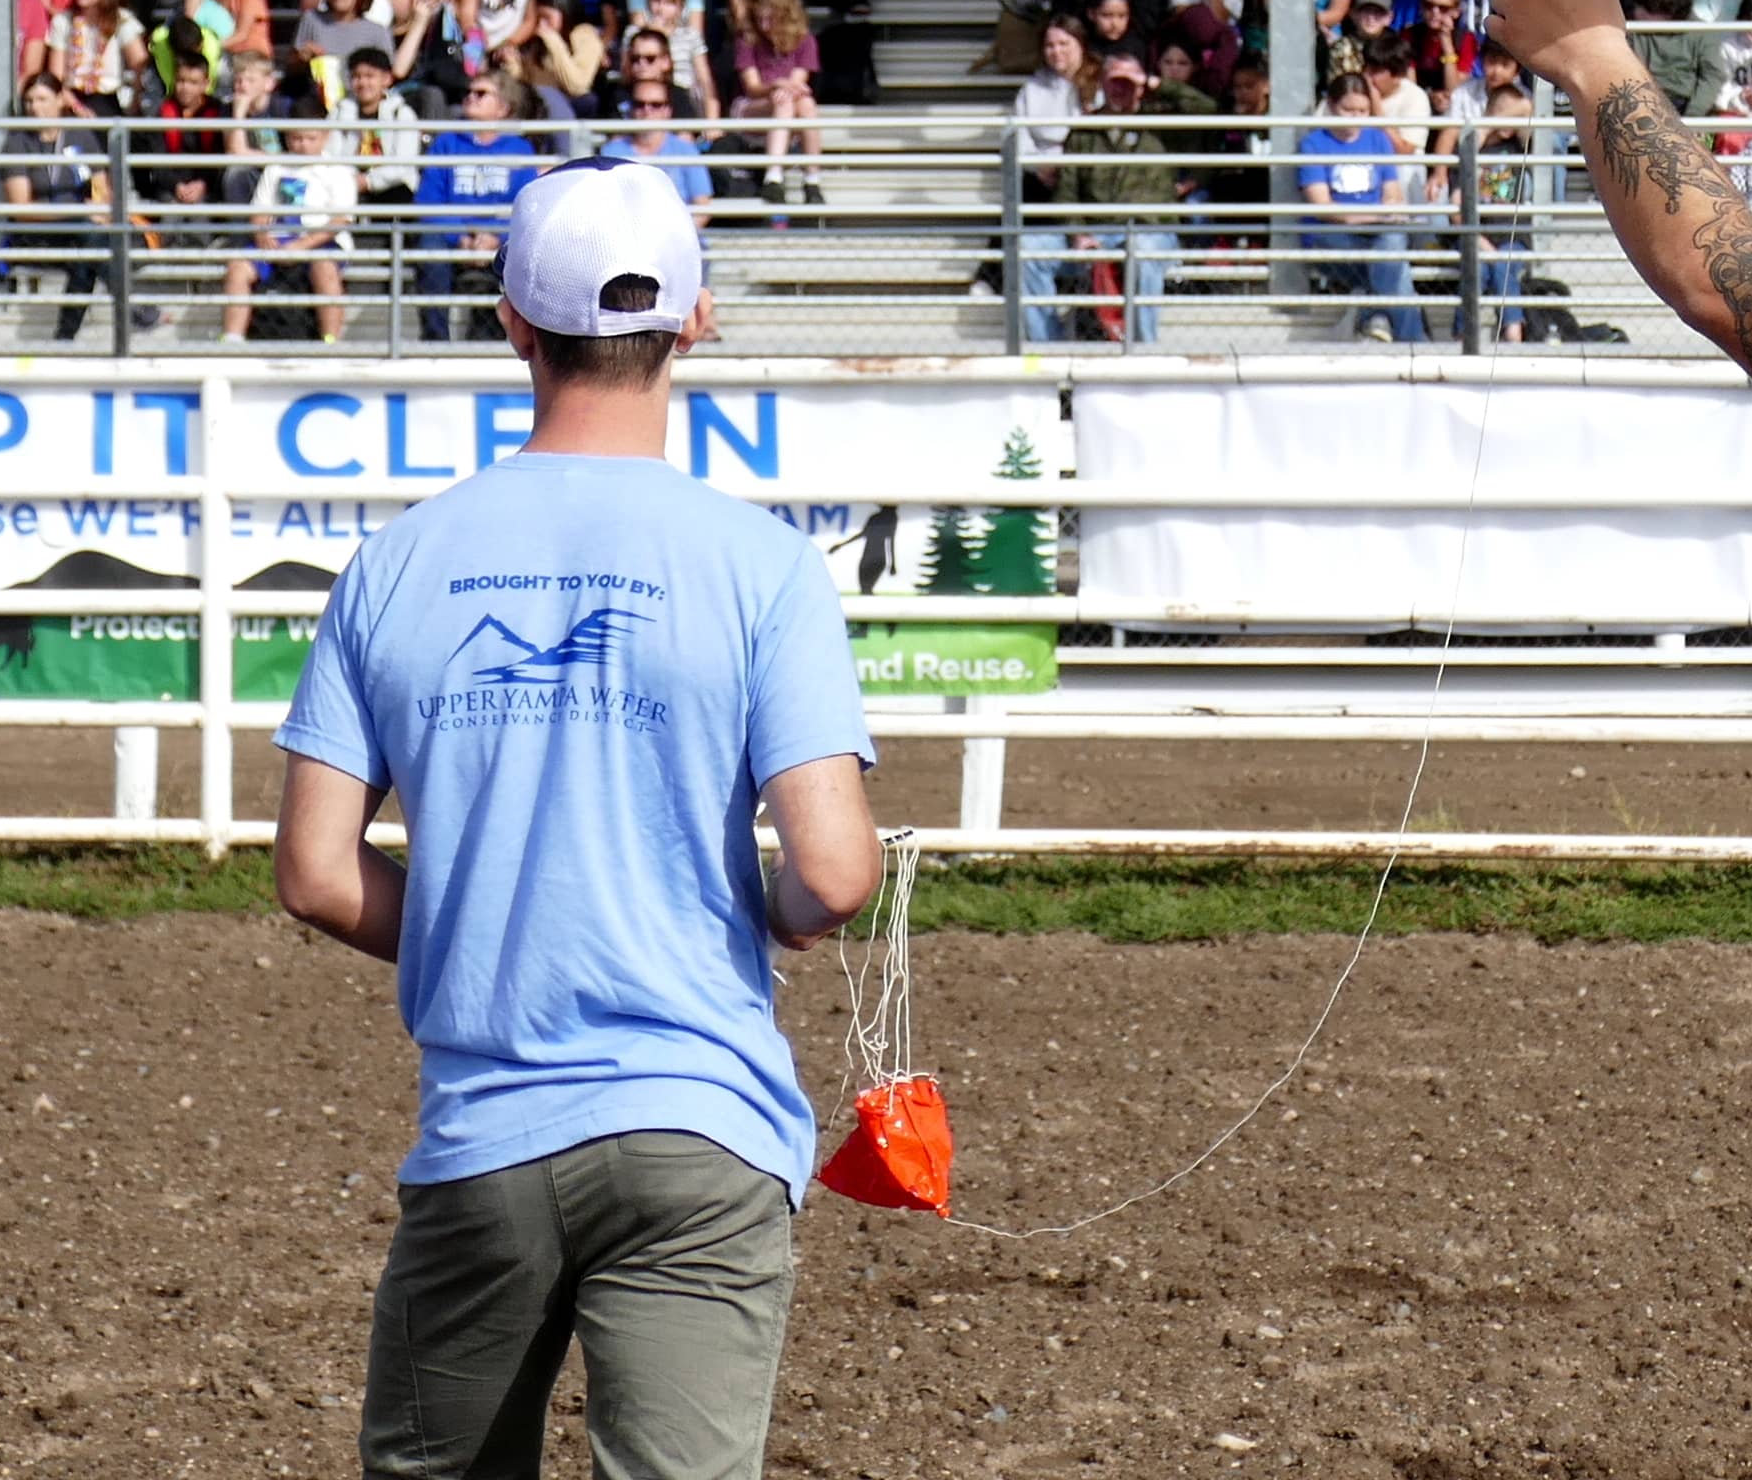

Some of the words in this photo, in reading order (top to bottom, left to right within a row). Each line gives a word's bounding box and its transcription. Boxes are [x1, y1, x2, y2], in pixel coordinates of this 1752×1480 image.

[93, 391, 202, 477] IT
[276, 392, 779, 479] CLEN
[276, 501, 375, 537] ALL
[449, 575, 552, 595] BROUGHT
[557, 574, 582, 591] TO
[586, 573, 628, 589] YOU
[629, 579, 666, 601] BY:
[857, 650, 904, 682] nd
[913, 651, 1035, 682] Reuse.
[417, 689, 498, 720] UPPER
